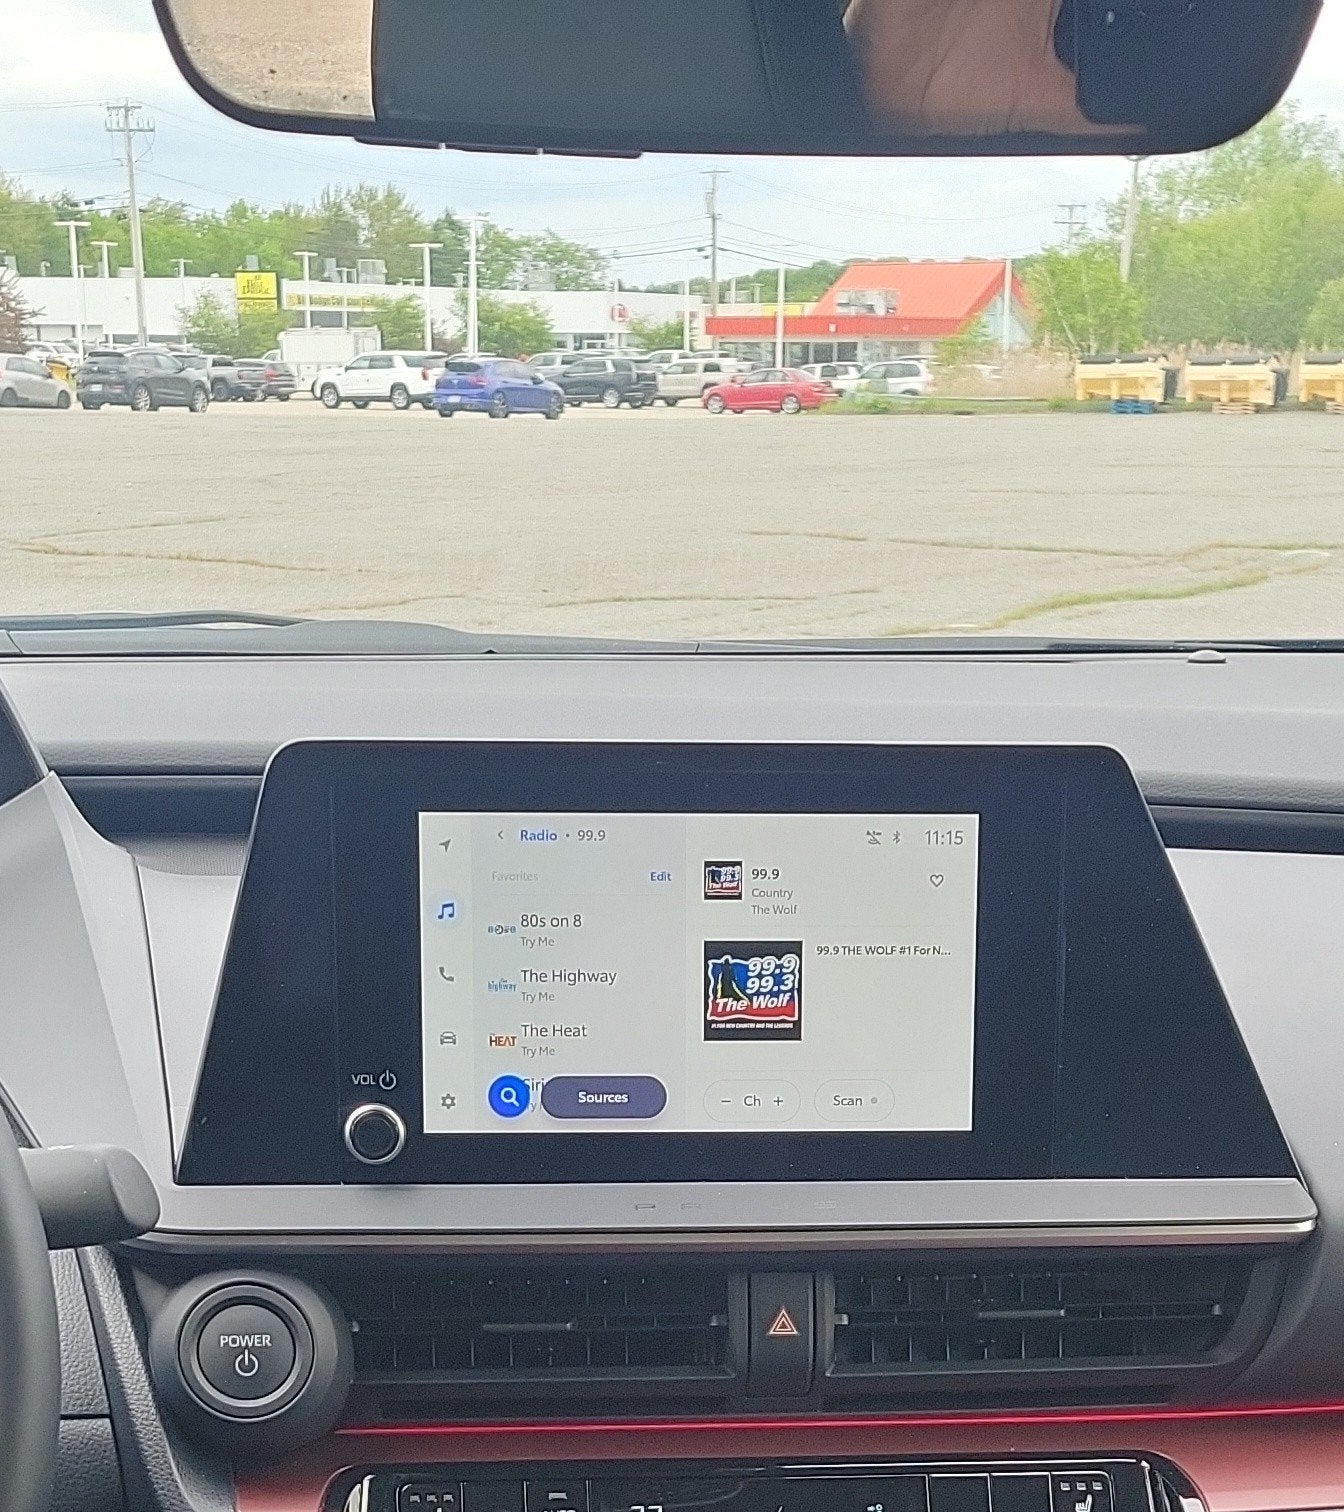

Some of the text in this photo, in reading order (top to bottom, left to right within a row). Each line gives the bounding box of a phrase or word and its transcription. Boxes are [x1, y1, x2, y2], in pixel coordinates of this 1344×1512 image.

[520, 829, 606, 842] Radio 99.9
[924, 830, 965, 845] 11:15
[492, 871, 539, 882] Favorites
[650, 871, 672, 882] Edit
[751, 868, 780, 880] 99.9
[751, 888, 794, 901] Country
[751, 904, 797, 915] The Wolf
[520, 914, 582, 928] 80s on 8
[521, 936, 555, 949] Try Me
[816, 945, 840, 956] 99.9
[842, 945, 862, 956] THE
[865, 945, 896, 956] WOLF
[898, 945, 911, 956] #1
[914, 945, 931, 956] For
[747, 957, 796, 977] 99.9
[521, 969, 618, 986] The Highway
[746, 974, 794, 993] 99.3
[522, 992, 555, 1004] Try Me
[716, 993, 792, 1013] The Wolf
[521, 1024, 588, 1037] The Heat
[489, 1035, 517, 1047] HEAT
[522, 1046, 556, 1059] Try Me
[351, 1074, 376, 1086] VOL
[578, 1091, 629, 1104] Sources
[743, 1095, 762, 1107] Ch
[833, 1095, 863, 1107] Scan
[219, 1333, 272, 1349] POWER
